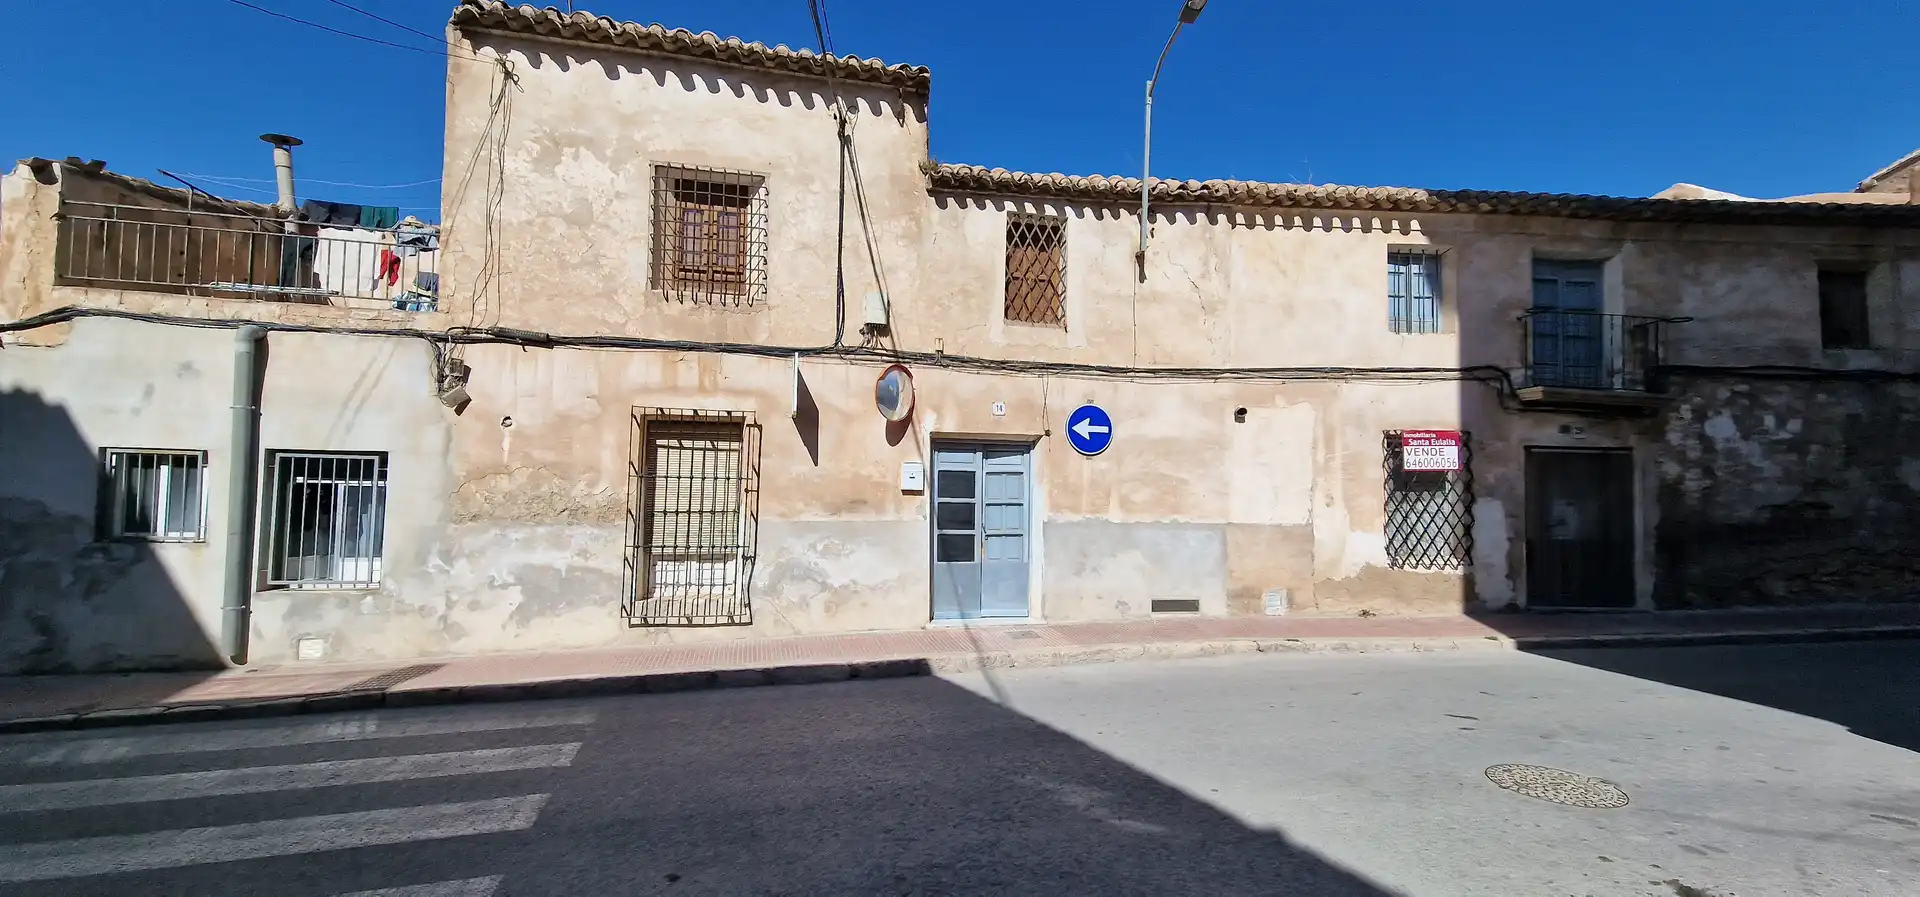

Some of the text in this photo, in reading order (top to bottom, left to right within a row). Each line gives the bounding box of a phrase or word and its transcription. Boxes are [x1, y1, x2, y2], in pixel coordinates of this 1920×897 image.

[1408, 438, 1456, 446] Santa Eulalia
[1405, 447, 1445, 456] VENDE
[1405, 458, 1457, 468] 646006056
